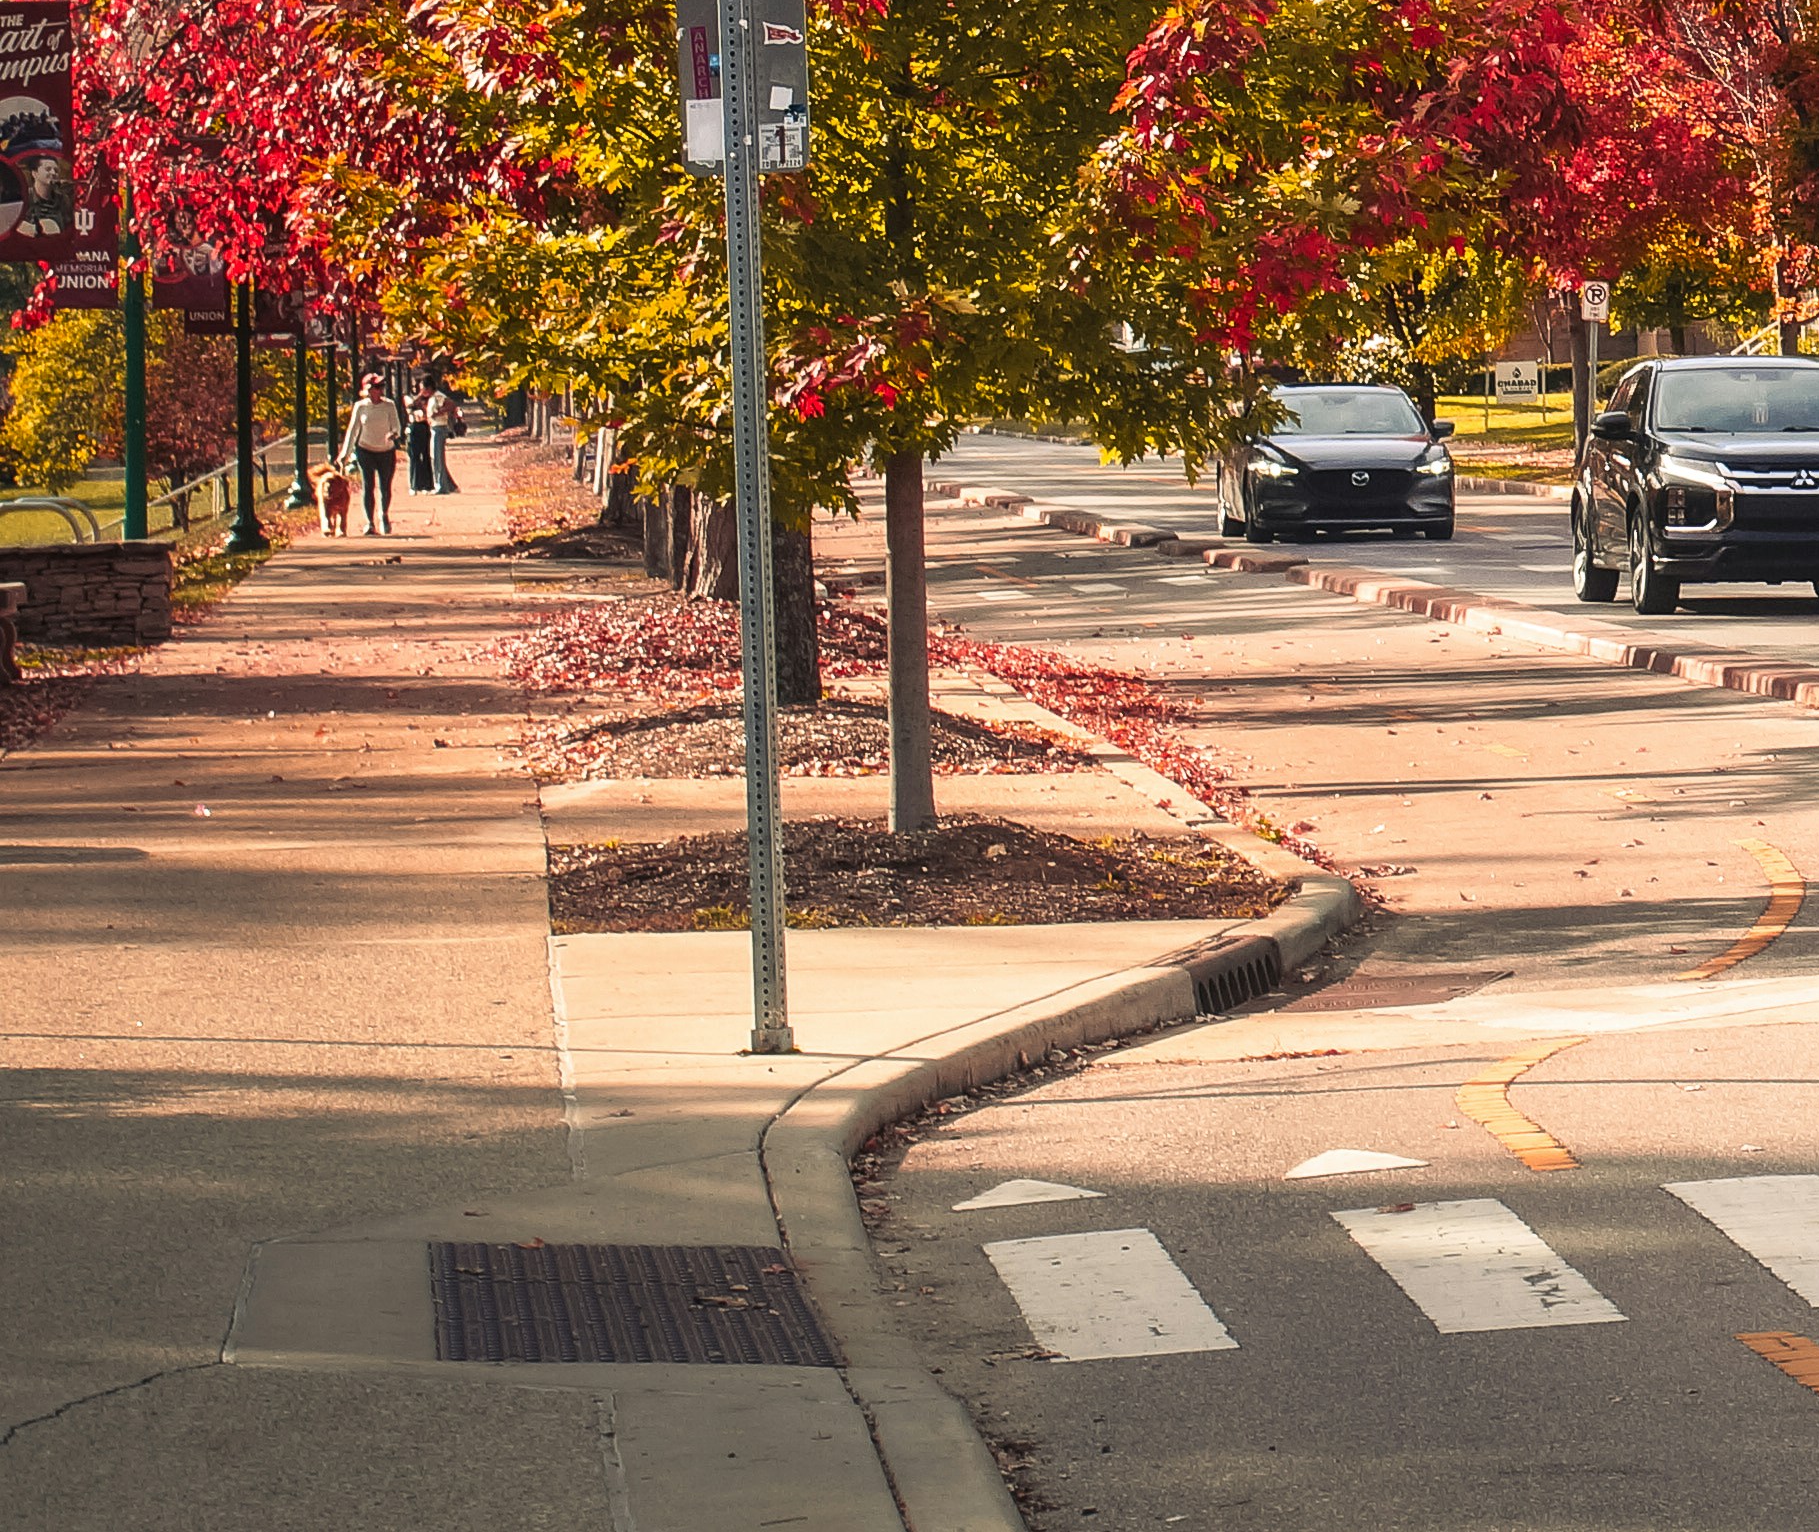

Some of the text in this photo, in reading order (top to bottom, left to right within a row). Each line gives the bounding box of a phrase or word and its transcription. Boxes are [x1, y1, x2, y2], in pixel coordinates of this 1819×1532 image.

[0, 14, 24, 28] THE
[0, 18, 68, 53] art of
[0, 52, 70, 87] mpus
[189, 311, 225, 322] UNION
